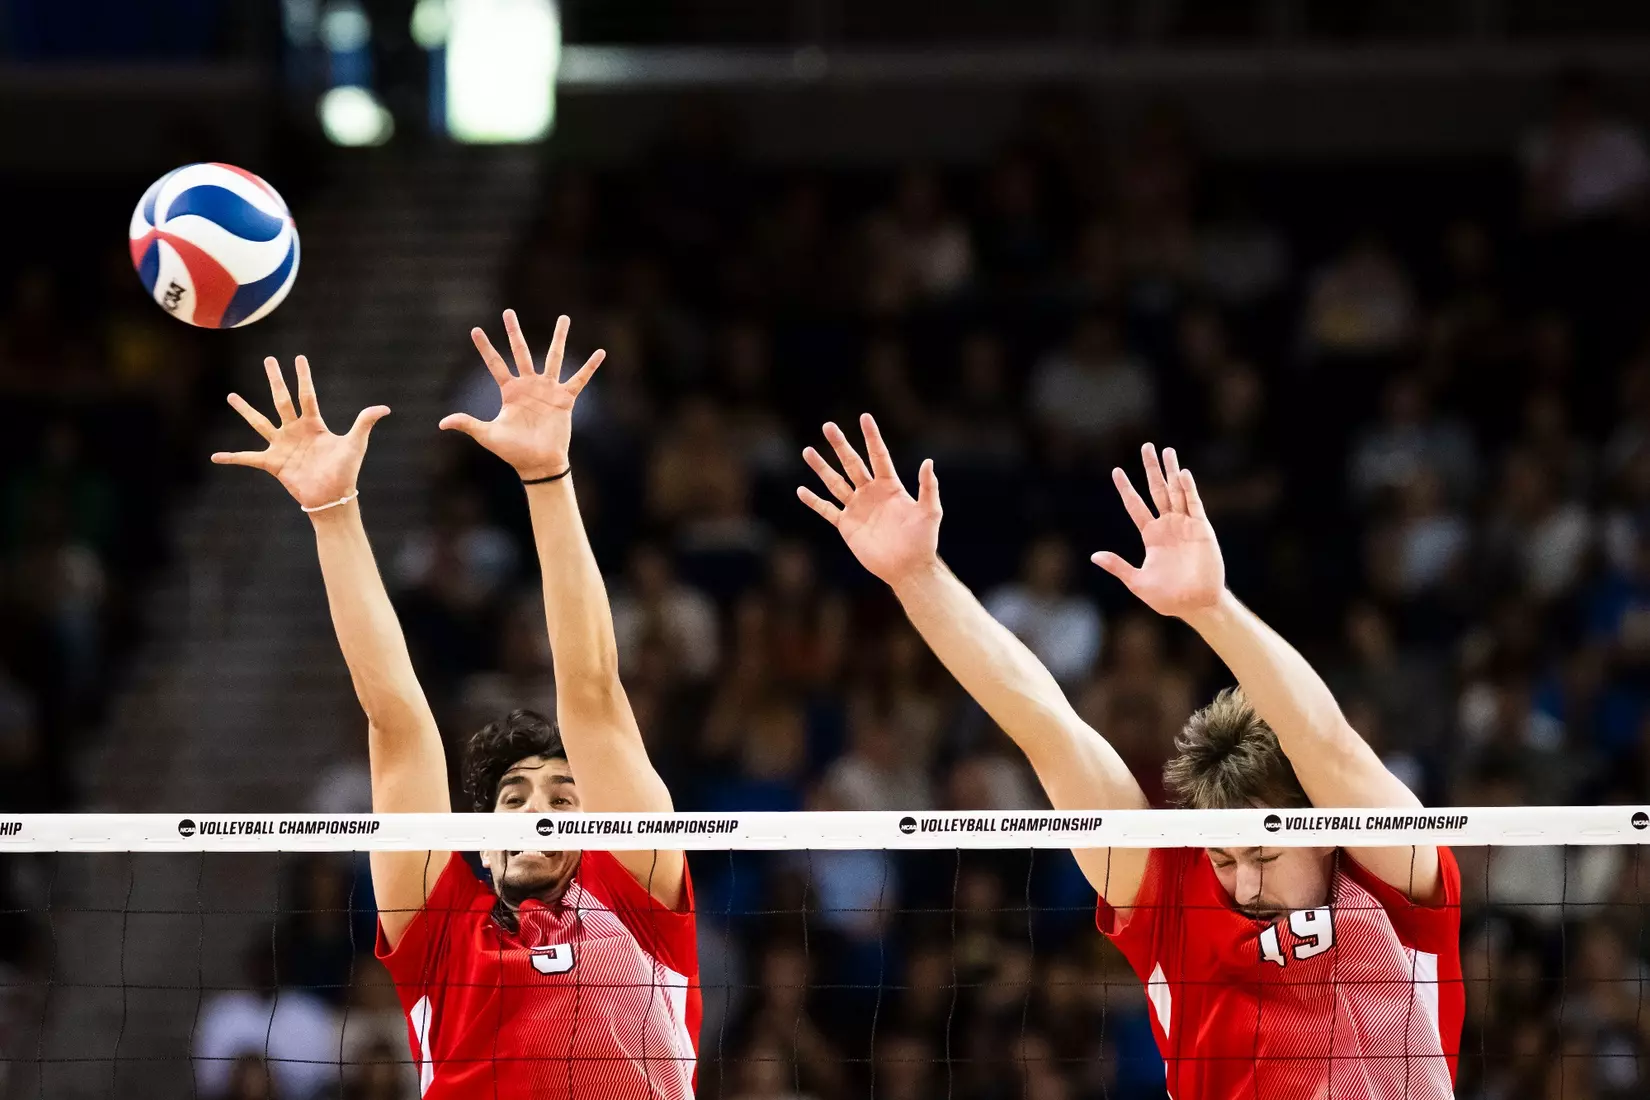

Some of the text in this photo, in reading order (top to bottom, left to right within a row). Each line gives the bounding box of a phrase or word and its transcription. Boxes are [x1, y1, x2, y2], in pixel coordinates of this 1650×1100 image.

[199, 821, 275, 836] VOLLEYBALL
[279, 820, 380, 835] CHAMPIONSHIP
[557, 820, 633, 835] VOLLEYBALL
[637, 819, 739, 834] CHAMPIONSHIP
[920, 818, 997, 833] VOLLEYBALL
[1000, 817, 1103, 832] CHAMPIONSHIP
[1285, 816, 1362, 831] VOLLEYBALL
[1365, 815, 1469, 830] CHAMPIONSHIP
[1259, 905, 1335, 967] 19
